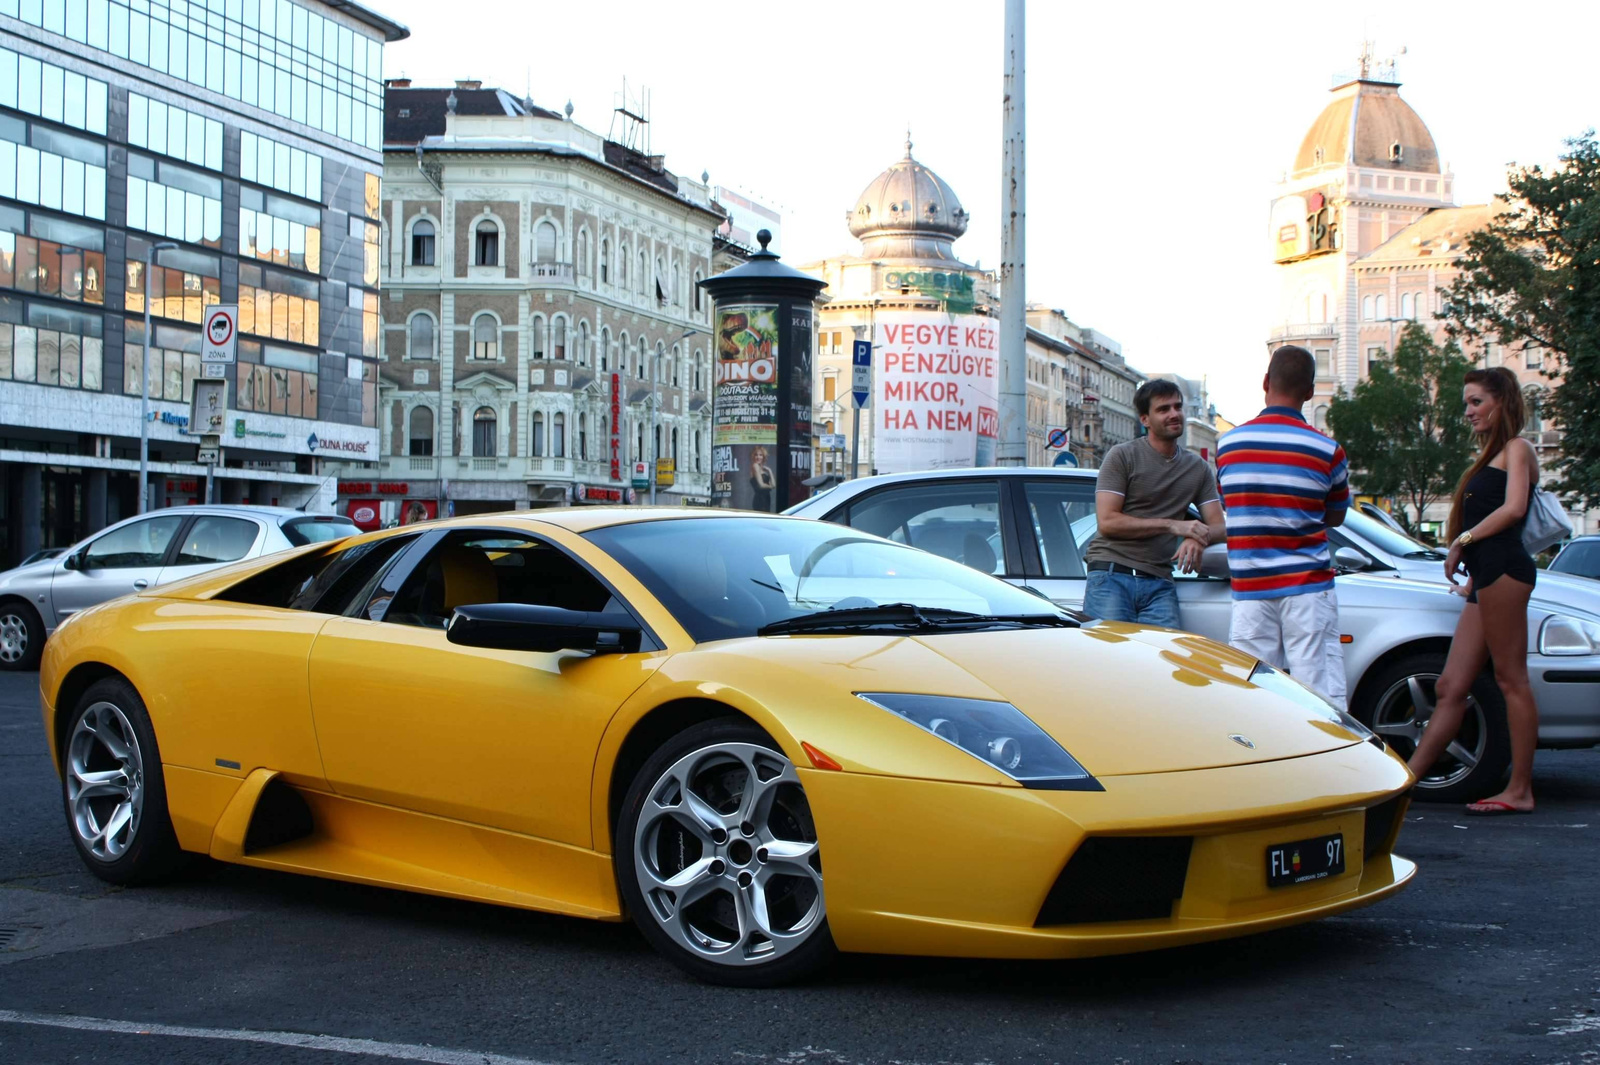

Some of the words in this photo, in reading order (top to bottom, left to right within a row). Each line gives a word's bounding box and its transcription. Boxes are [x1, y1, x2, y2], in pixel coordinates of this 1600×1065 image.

[884, 324, 959, 346] VEGYE
[965, 322, 998, 351] KÉZ
[857, 345, 867, 363] P
[611, 373, 619, 434] BURGER
[884, 381, 964, 406] MIKOR,
[884, 409, 919, 430] HA
[926, 410, 973, 432] NEM
[320, 439, 340, 450] DUNA
[342, 441, 367, 453] HOUSE
[610, 438, 620, 480] KING
[338, 483, 372, 495] RGER
[377, 483, 409, 495] KING
[1271, 849, 1290, 877] FL
[1326, 838, 1341, 867] 97
